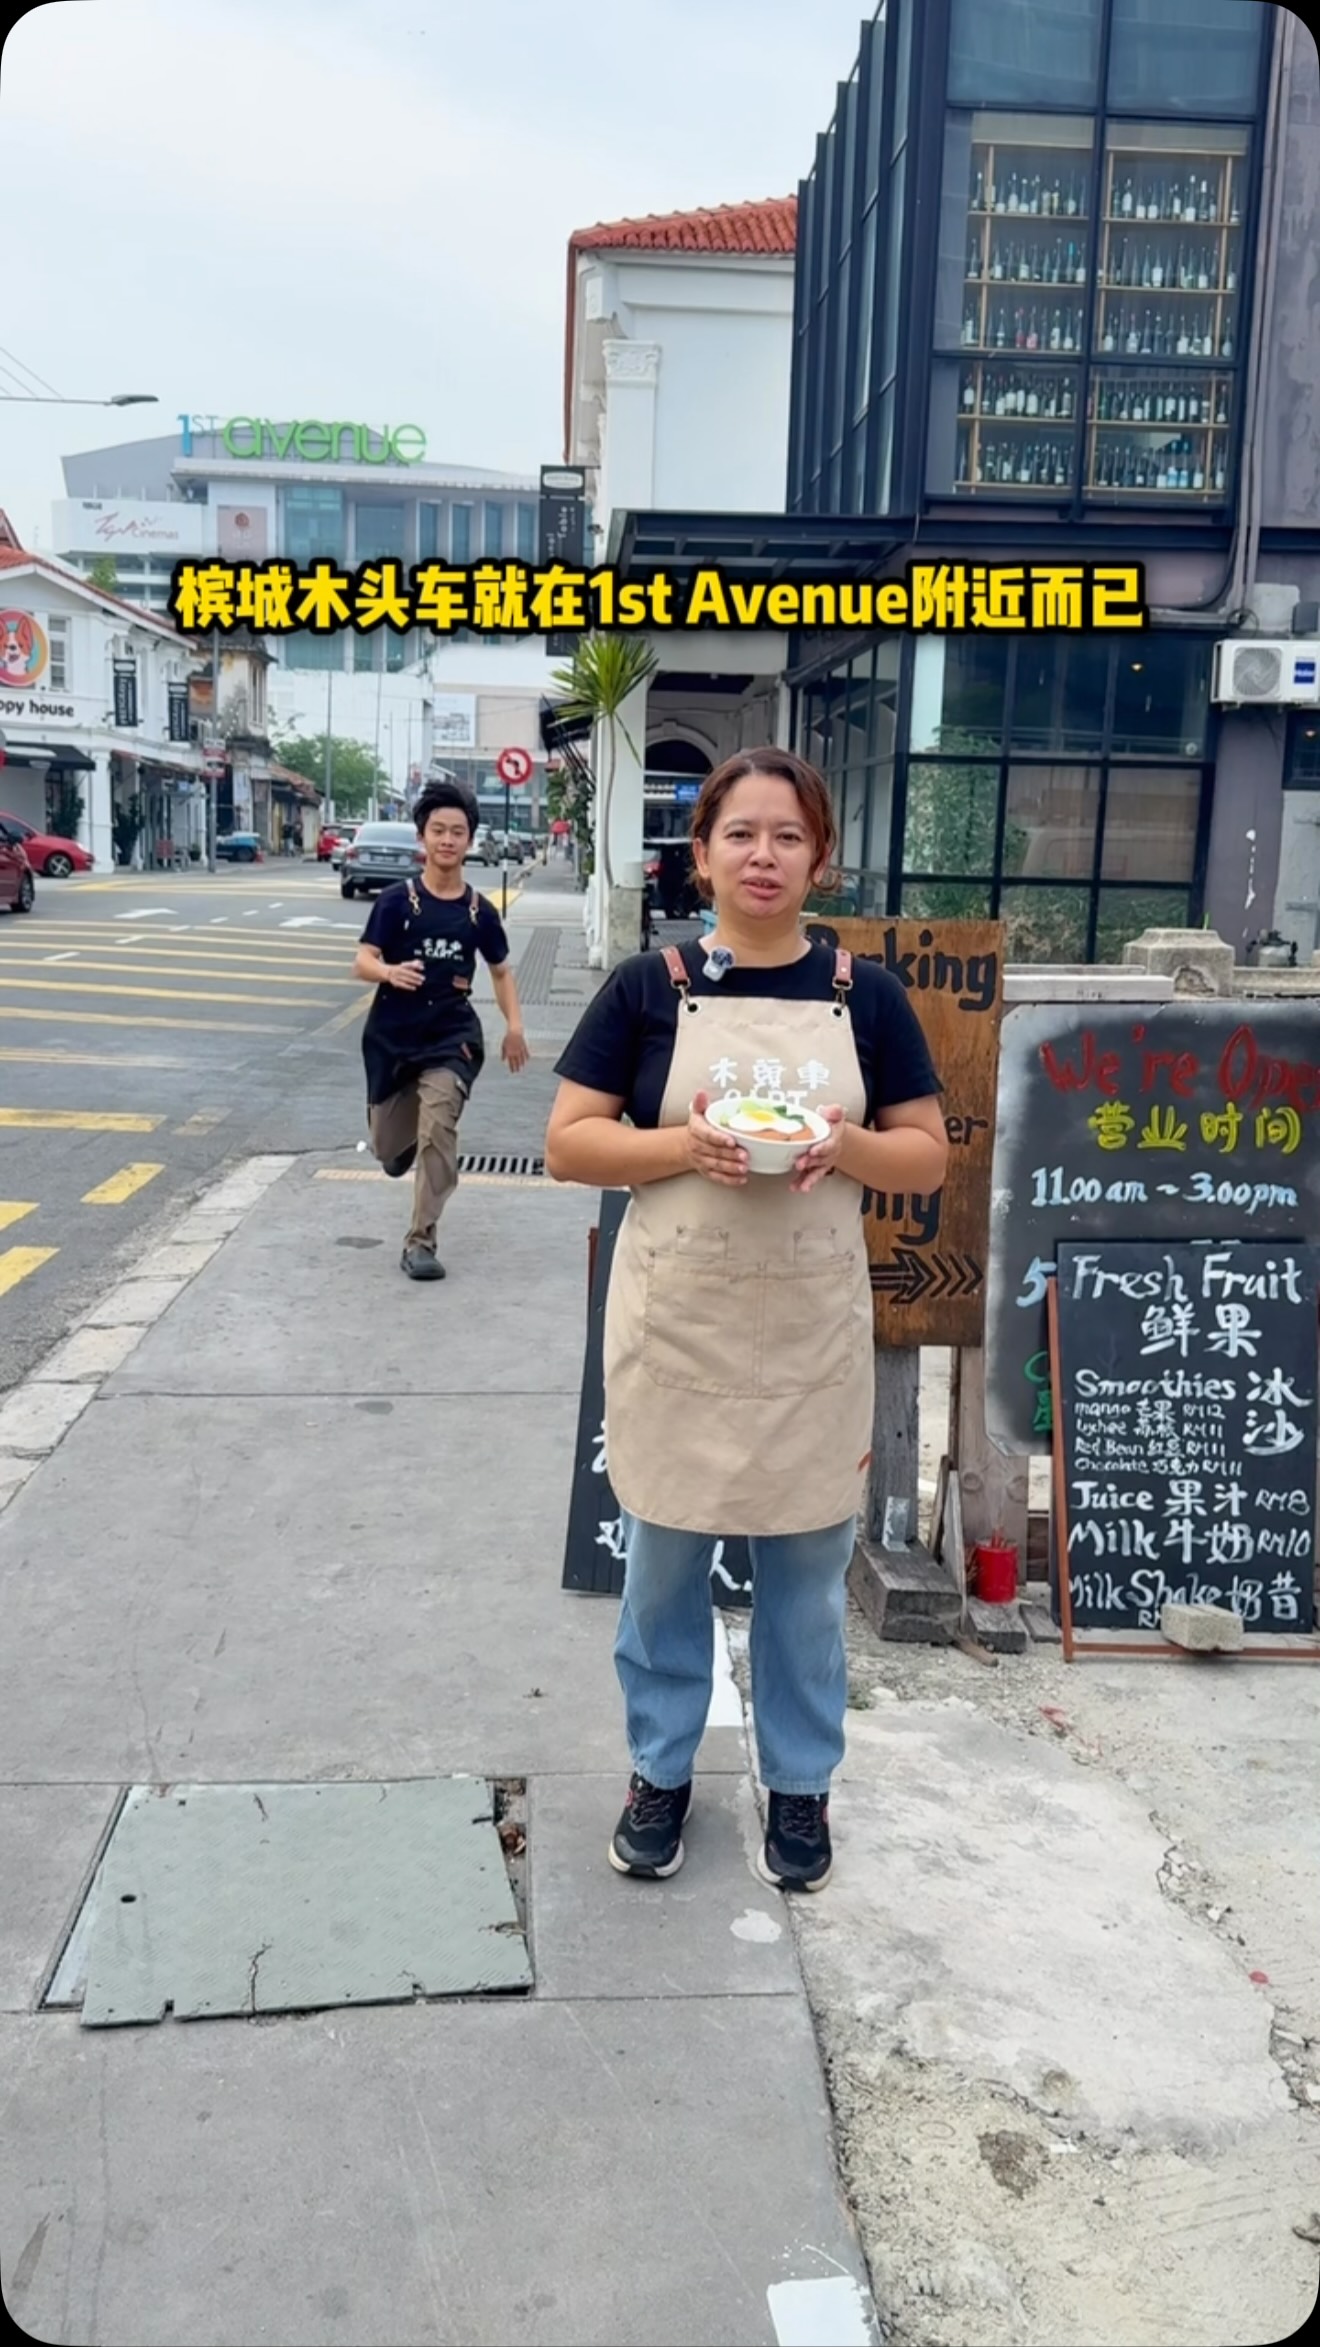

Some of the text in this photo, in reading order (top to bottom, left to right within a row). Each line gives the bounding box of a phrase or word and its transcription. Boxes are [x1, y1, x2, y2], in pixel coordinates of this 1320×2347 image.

[222, 416, 427, 466] avenue
[29, 699, 74, 718] house
[1039, 1023, 1198, 1097] We're
[1087, 1101, 1301, 1153] 营业时间
[1072, 1252, 1302, 1304] Fresh Fruit
[1139, 1302, 1262, 1358] 鲜果
[1074, 1368, 1237, 1400] Smoothies
[1182, 1422, 1223, 1439] RM11
[1183, 1403, 1226, 1420] RM12
[1242, 1367, 1314, 1456] 冰沙
[1074, 1436, 1101, 1457] Red
[1104, 1438, 1145, 1456] Bean
[1186, 1440, 1225, 1457] RM11
[1152, 1457, 1199, 1477] 巧克力
[1071, 1479, 1311, 1517] Juice 果汁 RM8
[1068, 1518, 1312, 1564] Milk 牛奶 RM10
[1224, 1569, 1302, 1622] 奶昔
